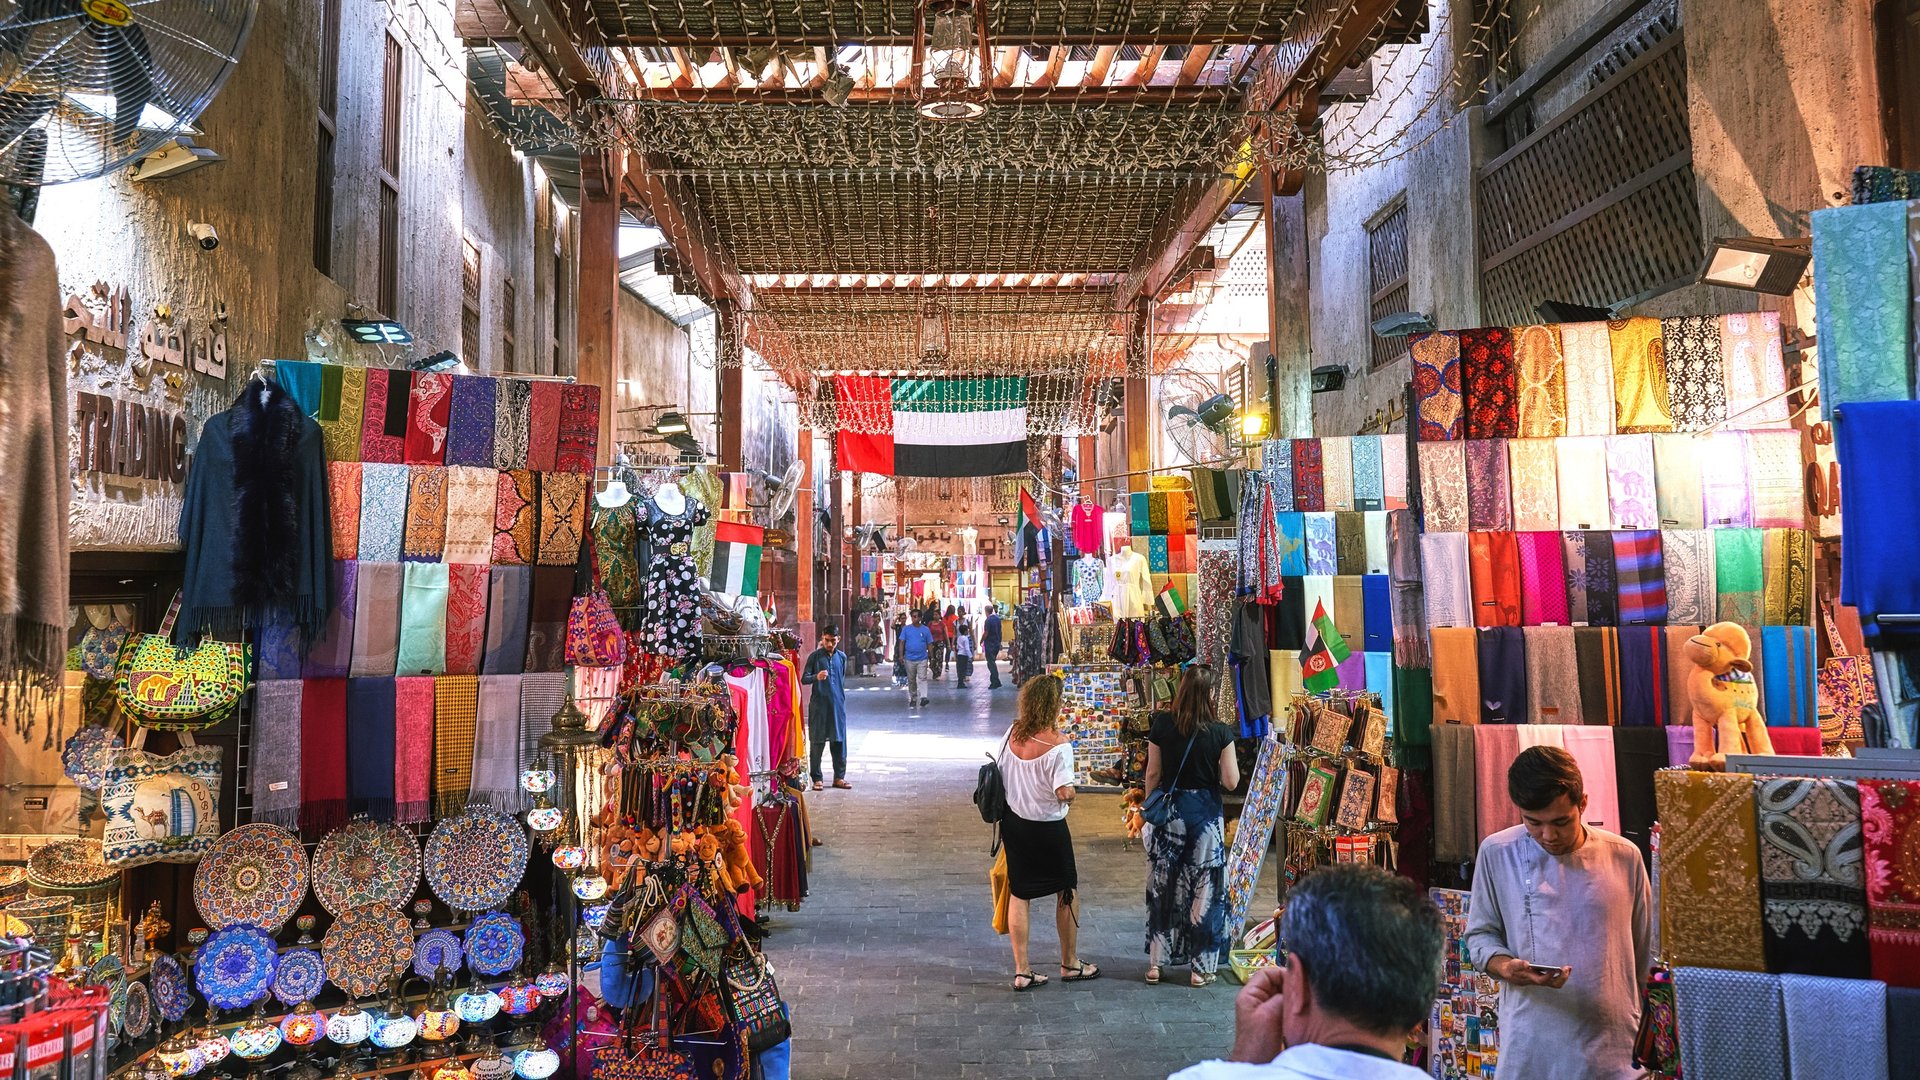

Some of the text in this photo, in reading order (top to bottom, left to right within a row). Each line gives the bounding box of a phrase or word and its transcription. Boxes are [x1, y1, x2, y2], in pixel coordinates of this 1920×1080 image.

[77, 391, 188, 484] TRADING
[190, 782, 209, 834] DUBAI
[29, 1038, 62, 1061] BOOKMARKS
